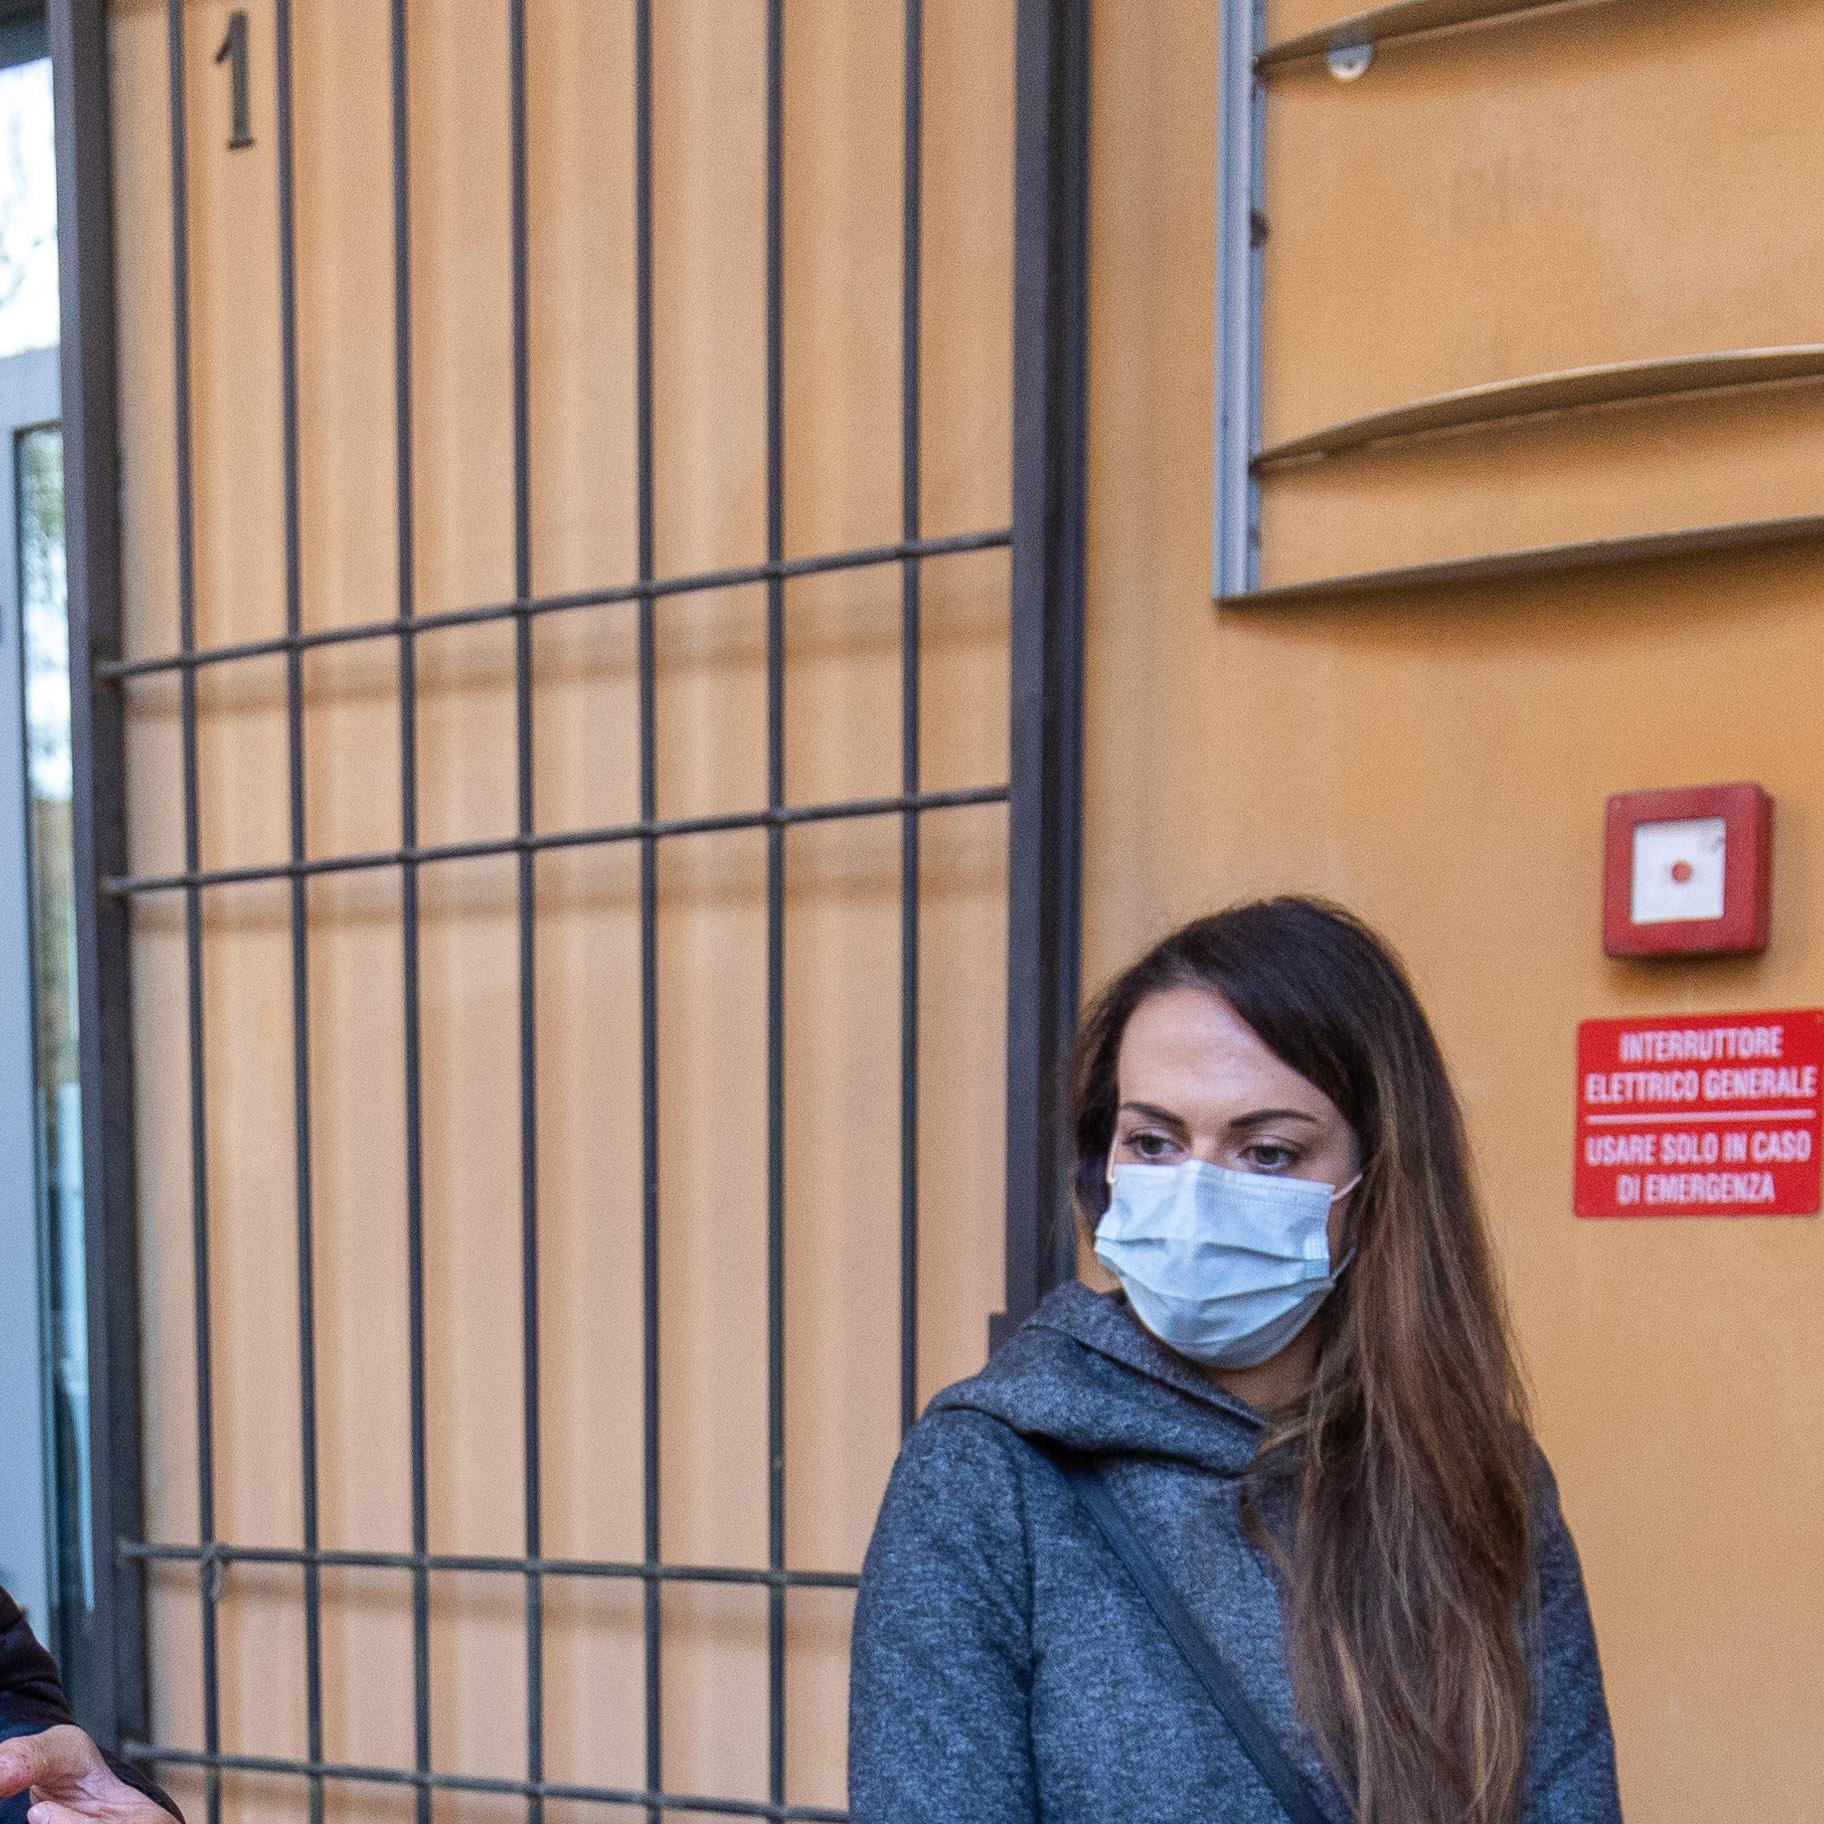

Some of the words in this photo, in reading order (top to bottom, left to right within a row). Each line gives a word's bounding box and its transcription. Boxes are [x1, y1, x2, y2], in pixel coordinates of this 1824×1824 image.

[213, 9, 256, 150] 1
[1619, 1026, 1783, 1062] INTERRUTTORE
[1585, 1070, 1700, 1103] ELETTRICO
[1703, 1066, 1817, 1100] GENERALE
[1585, 1133, 1656, 1166] USARE
[1660, 1132, 1719, 1163] SOLO
[1723, 1132, 1747, 1163] IN
[1751, 1130, 1812, 1162] CASO
[1617, 1174, 1640, 1205] DI
[1645, 1171, 1776, 1204] EMERGENZA
